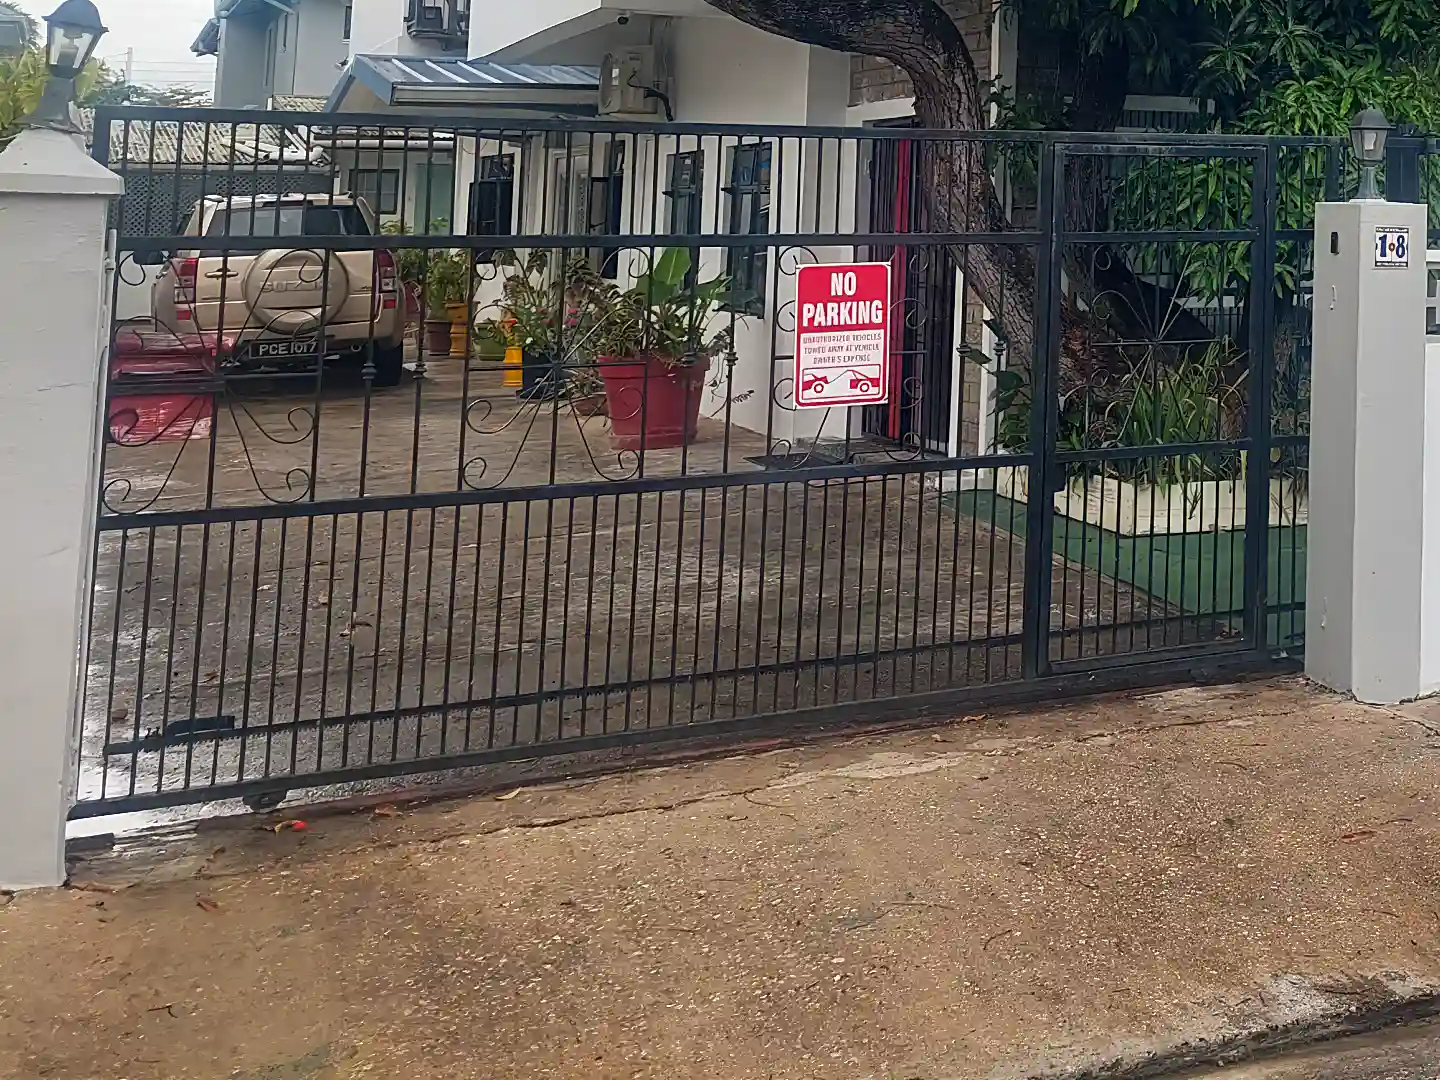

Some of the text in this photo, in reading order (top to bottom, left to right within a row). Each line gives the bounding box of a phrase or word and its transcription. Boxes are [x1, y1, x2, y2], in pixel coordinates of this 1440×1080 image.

[1378, 233, 1405, 258] 18
[830, 272, 857, 297] NO
[802, 300, 883, 327] PARKING
